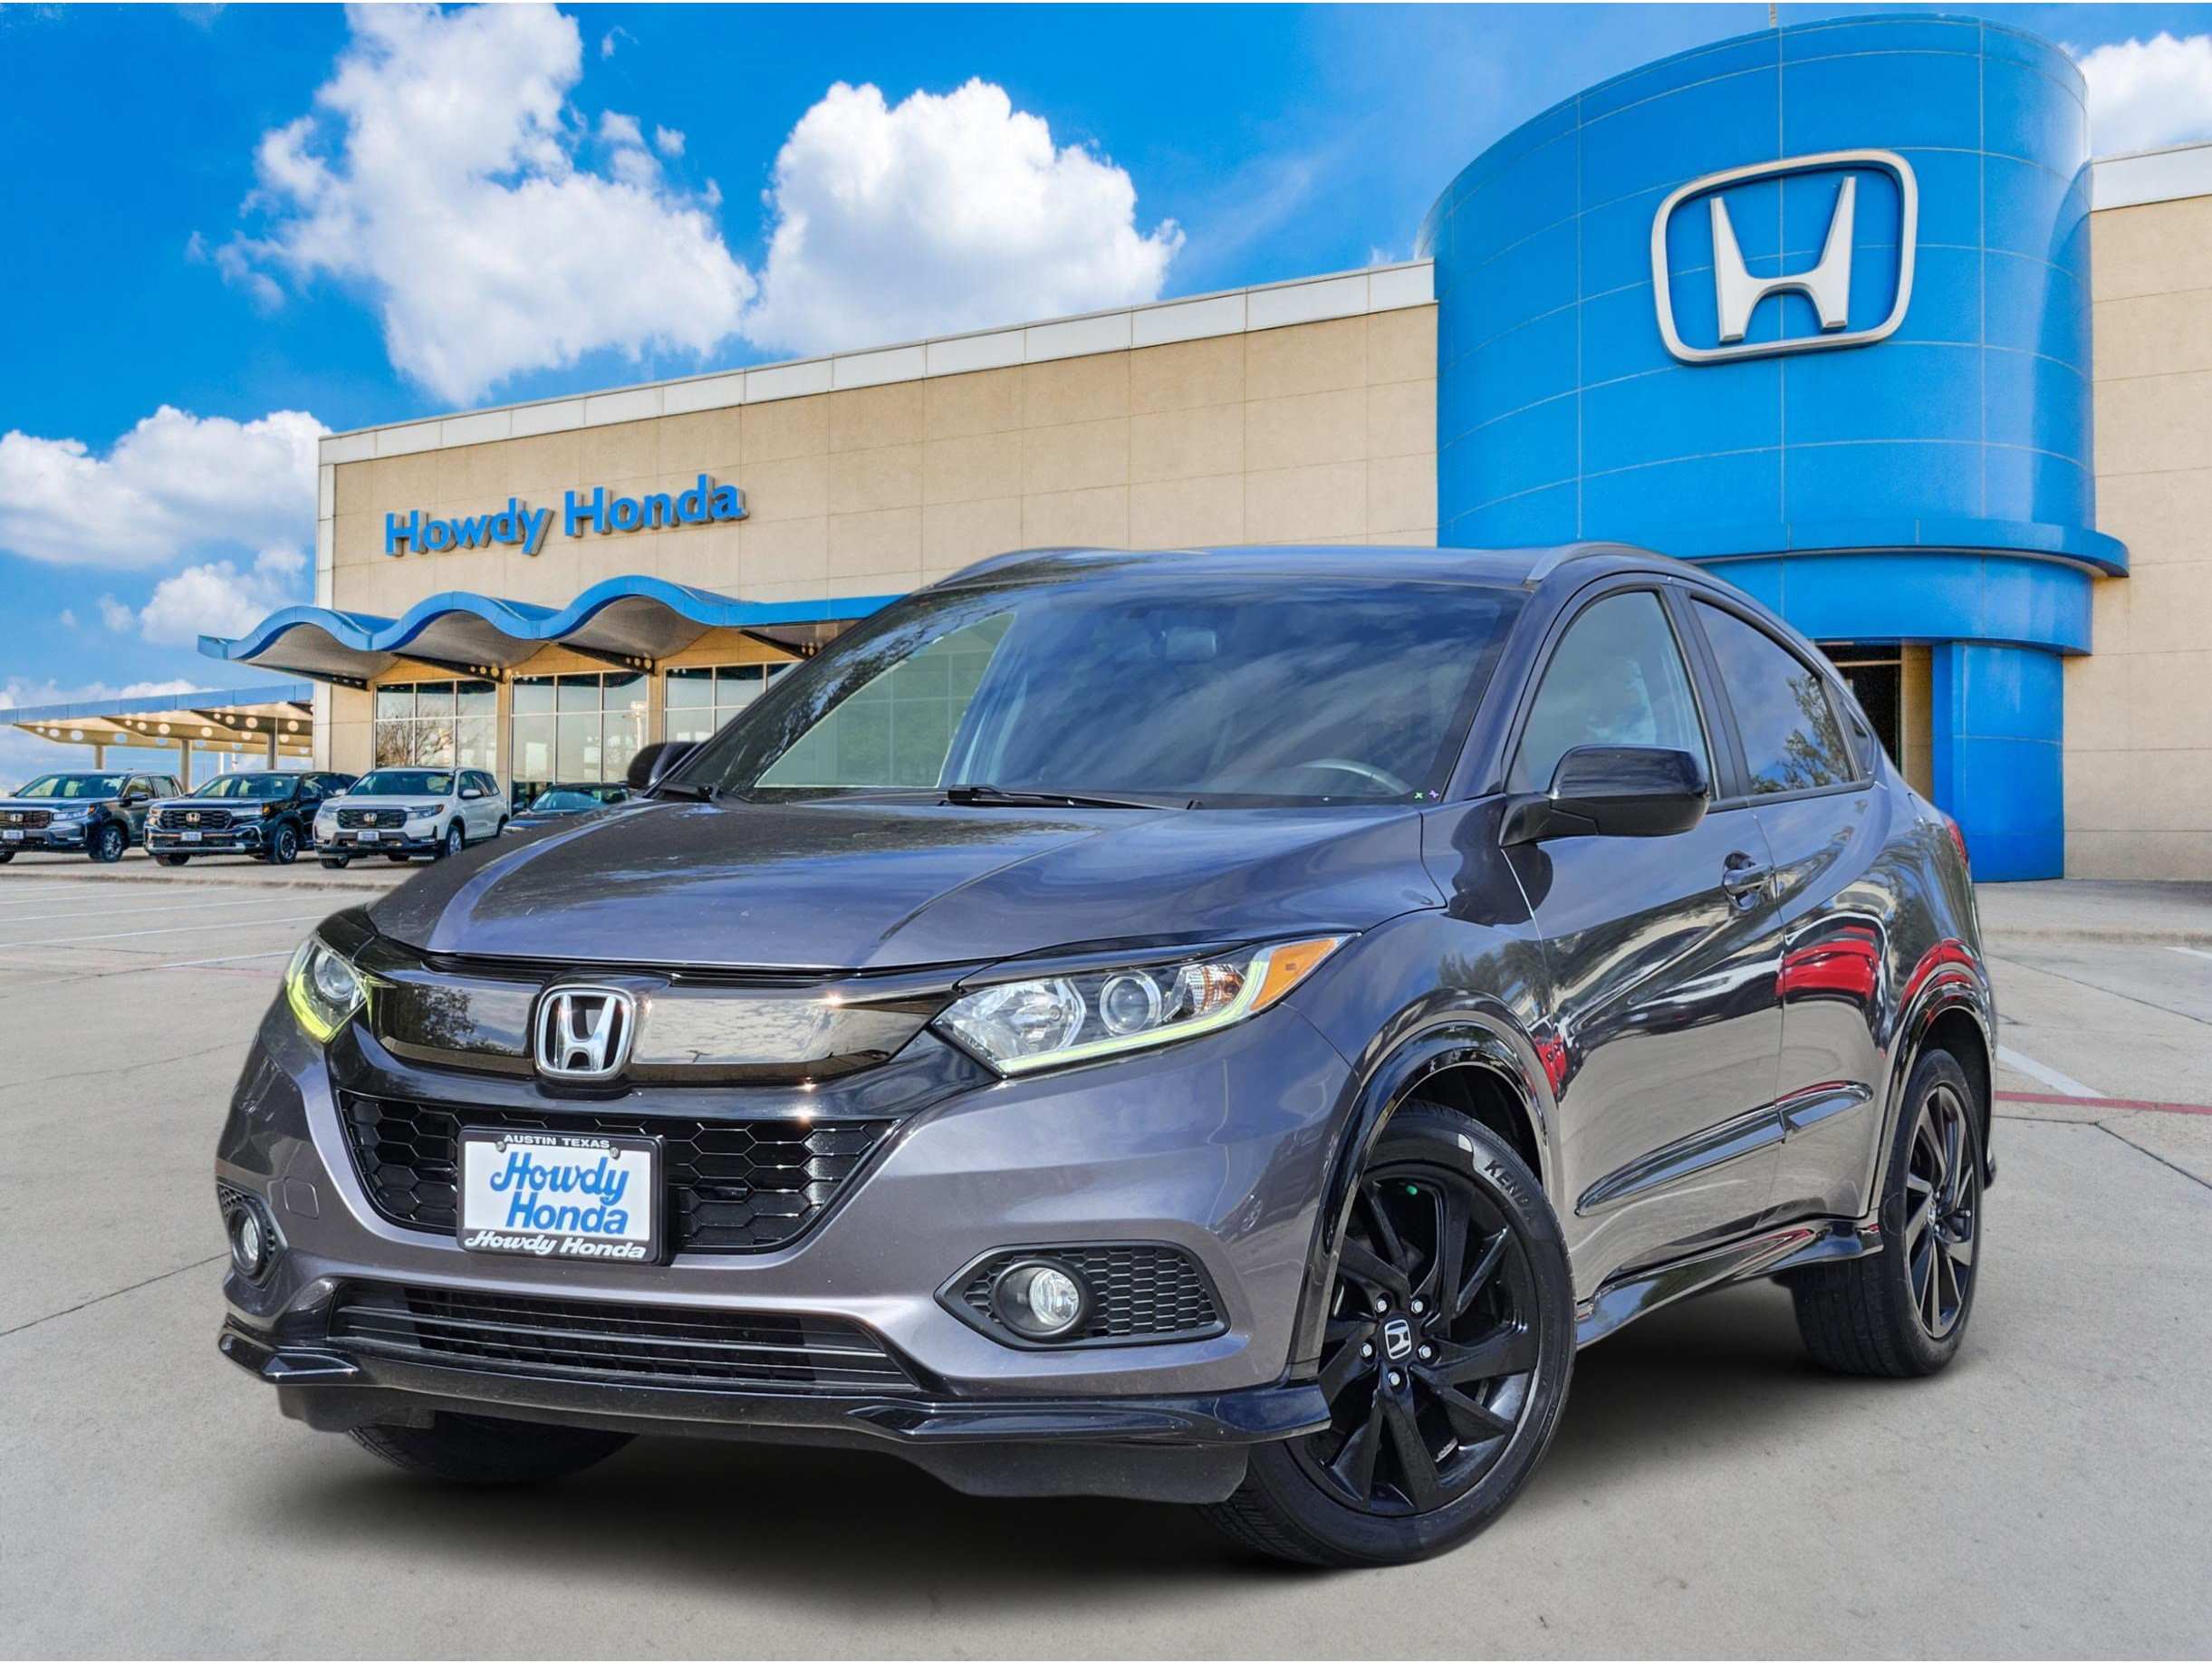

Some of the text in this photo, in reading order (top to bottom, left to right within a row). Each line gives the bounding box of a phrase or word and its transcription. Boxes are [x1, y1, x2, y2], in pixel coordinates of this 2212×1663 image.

[385, 473, 748, 556] Howdy Honda
[504, 1133, 611, 1149] AUSTIN TEXAS
[489, 1151, 630, 1206] Howdy
[505, 1190, 629, 1235] Honda
[464, 1230, 647, 1259] Howdy Honda
